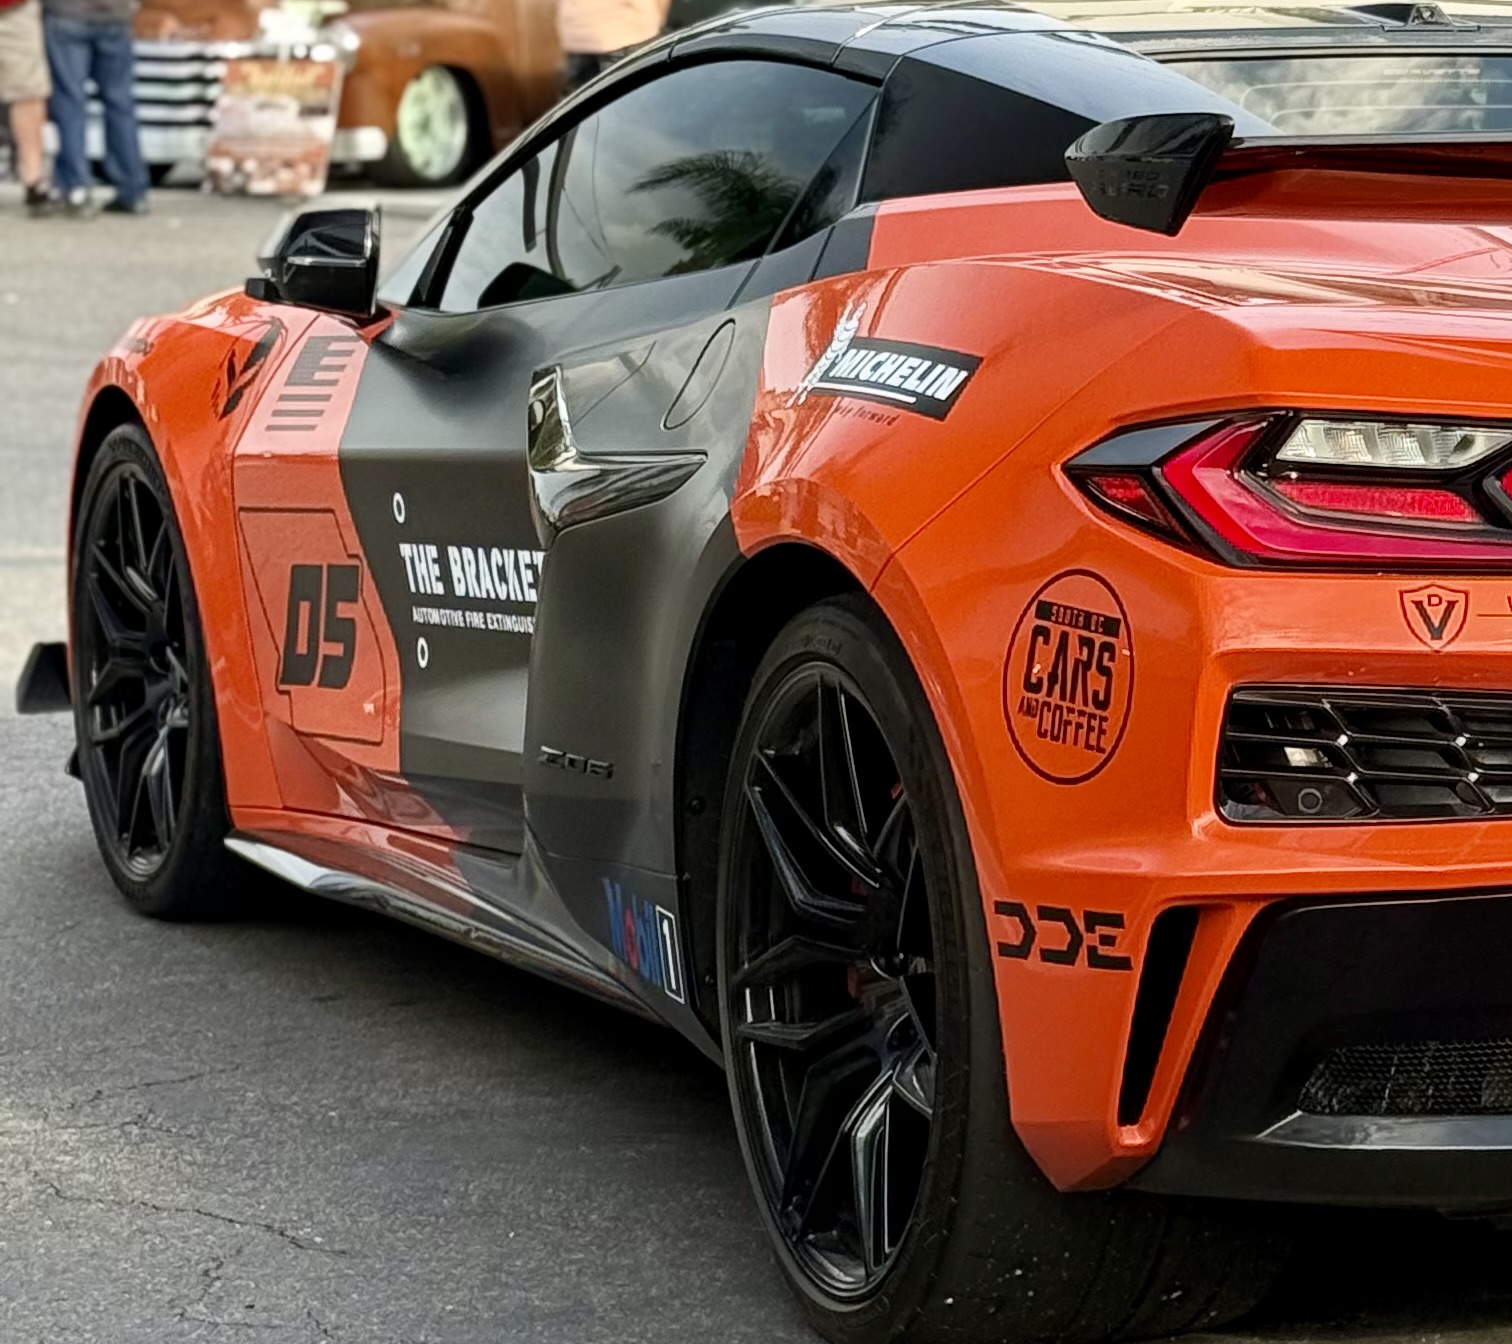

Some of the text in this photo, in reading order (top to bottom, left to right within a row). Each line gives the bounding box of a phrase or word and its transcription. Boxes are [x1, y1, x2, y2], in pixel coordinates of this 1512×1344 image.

[829, 348, 969, 401] MICHELIN
[399, 542, 445, 594] THE
[279, 564, 360, 689] 05
[412, 606, 466, 627] AUTOMOTIVE
[465, 611, 487, 629] FIRE
[1023, 624, 1116, 712] CARS
[1017, 696, 1110, 754] AND COFFEE
